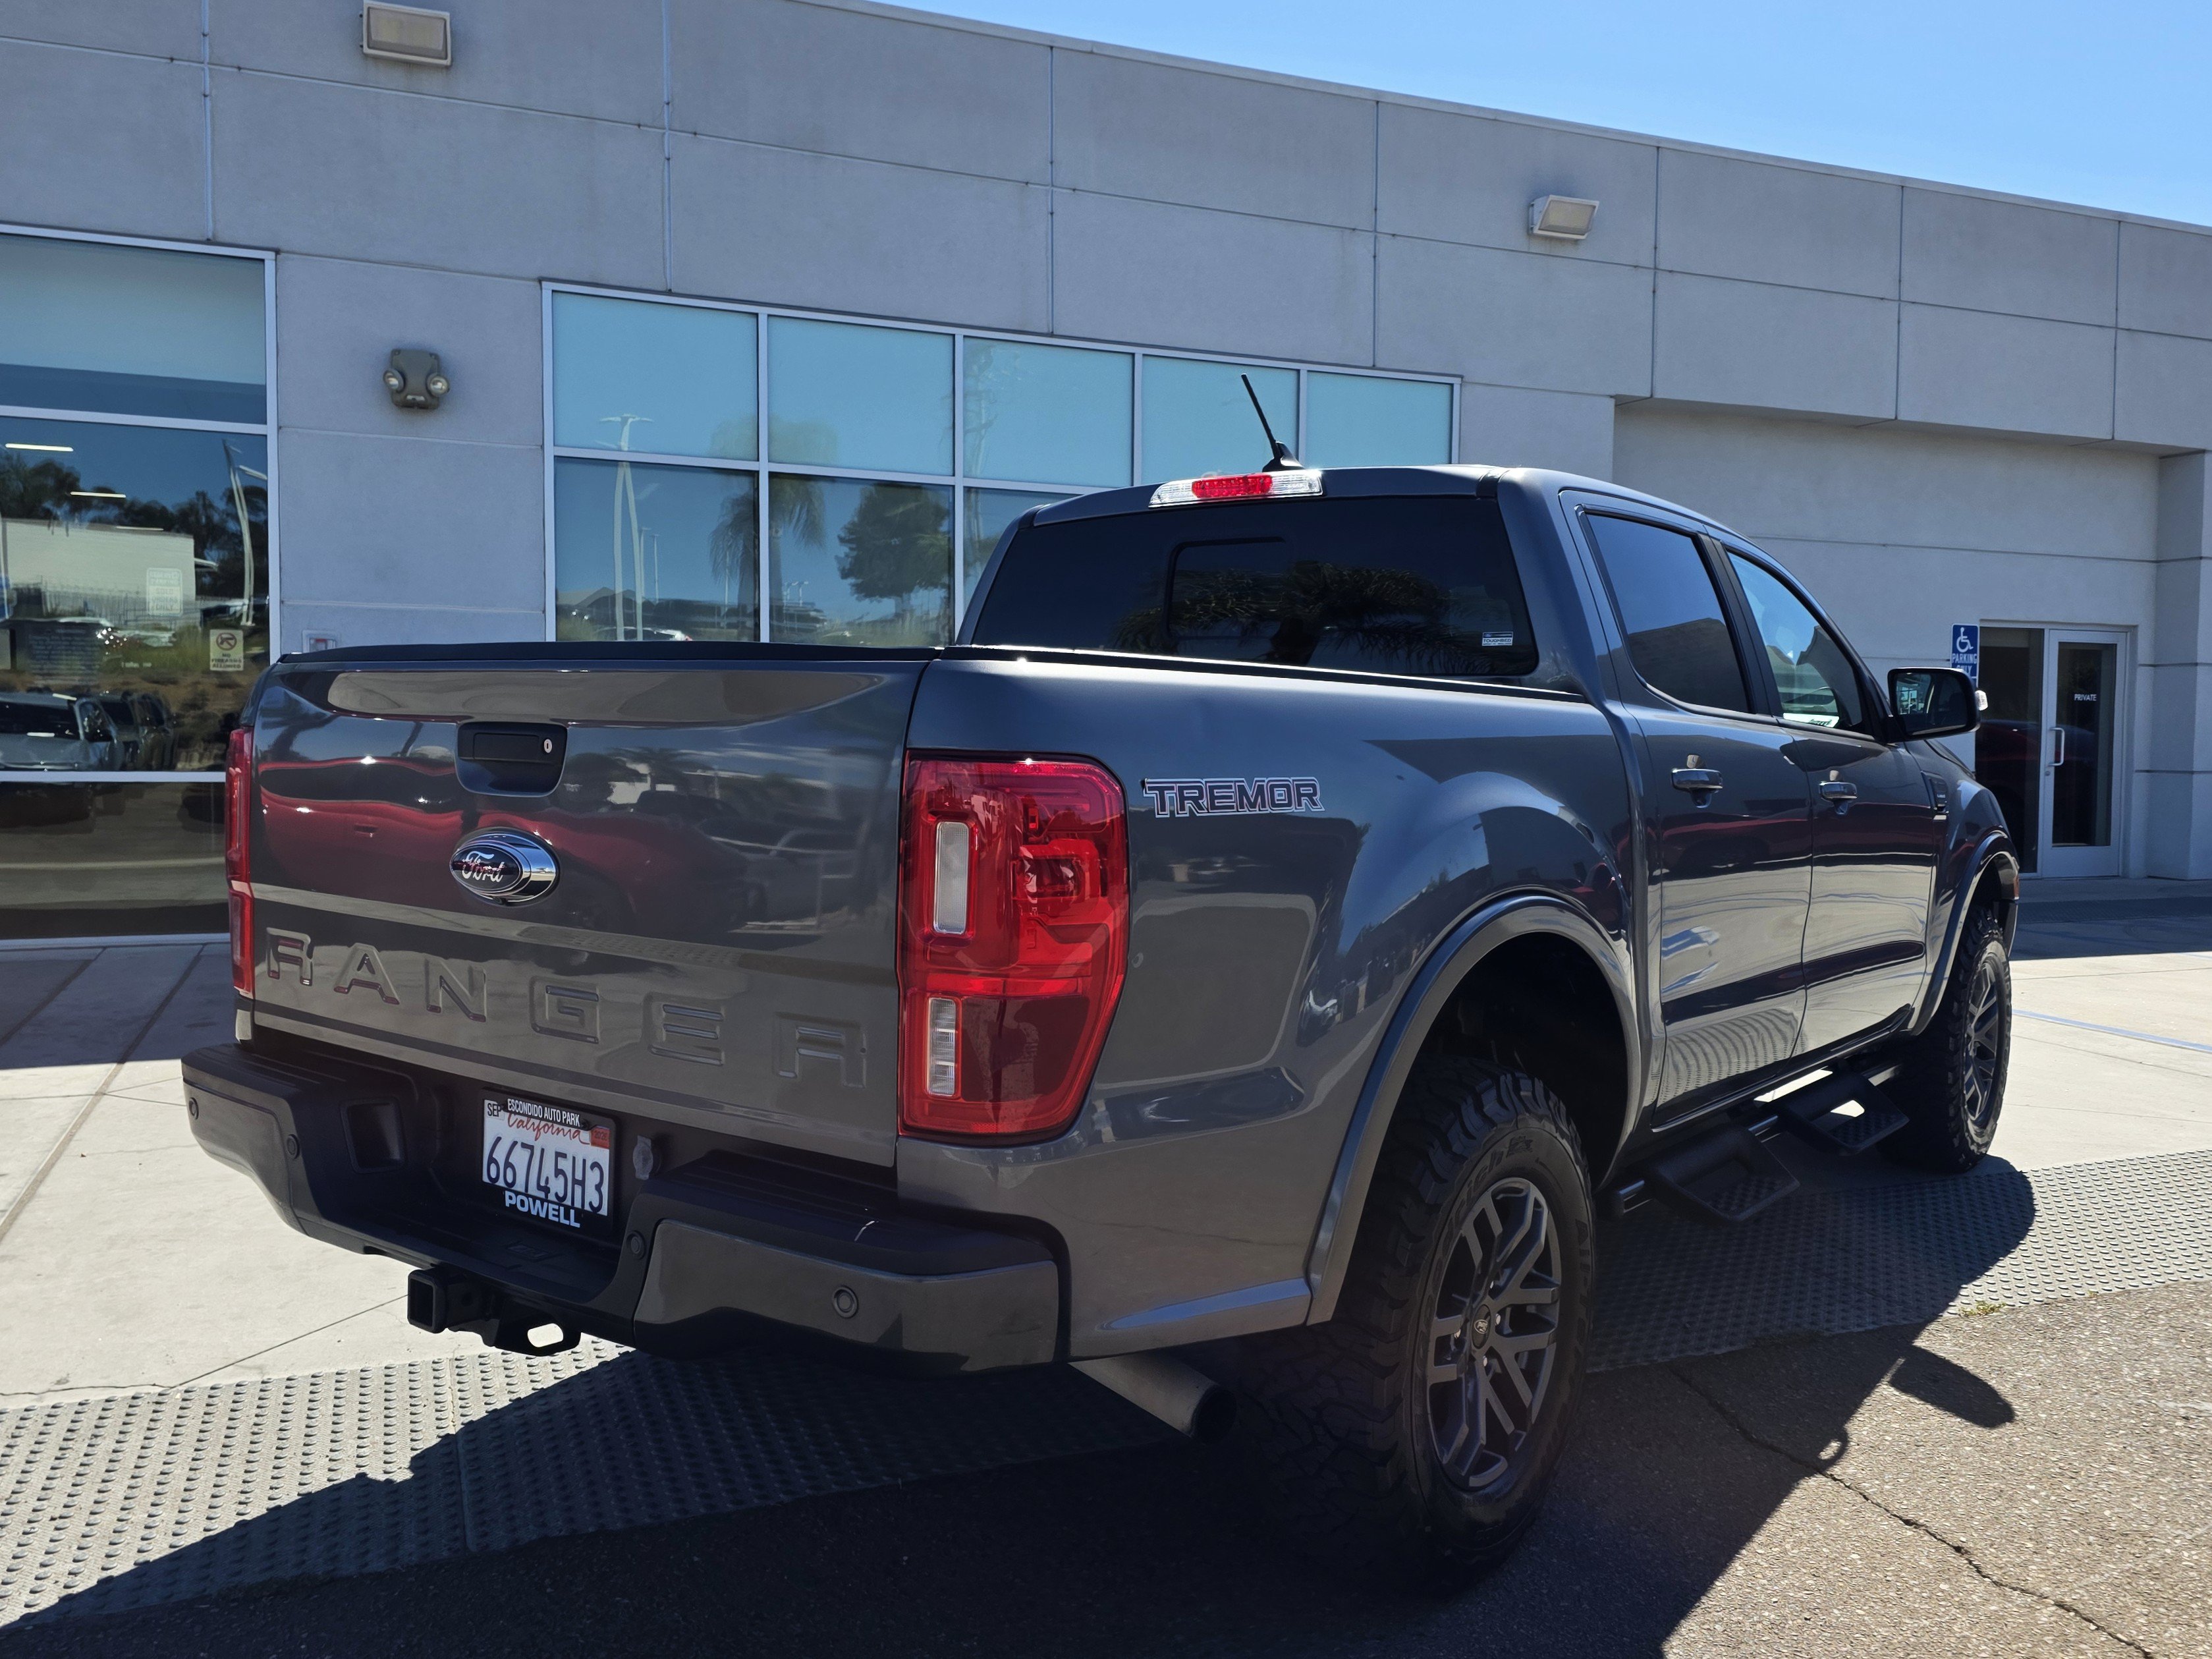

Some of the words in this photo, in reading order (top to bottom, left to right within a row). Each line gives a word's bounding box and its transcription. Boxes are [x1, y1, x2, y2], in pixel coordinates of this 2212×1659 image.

[1952, 653, 1977, 663] PARKING
[1143, 777, 1325, 818] TREMOR
[462, 851, 505, 883] Ford
[265, 926, 867, 1088] RANGER
[487, 1102, 501, 1117] SEP
[507, 1098, 543, 1118] ESCONDIDO
[544, 1106, 561, 1123] AUTO
[562, 1111, 580, 1127] PARK
[507, 1112, 590, 1145] California
[487, 1136, 605, 1213] 66745H3
[505, 1191, 580, 1228] POWELL
